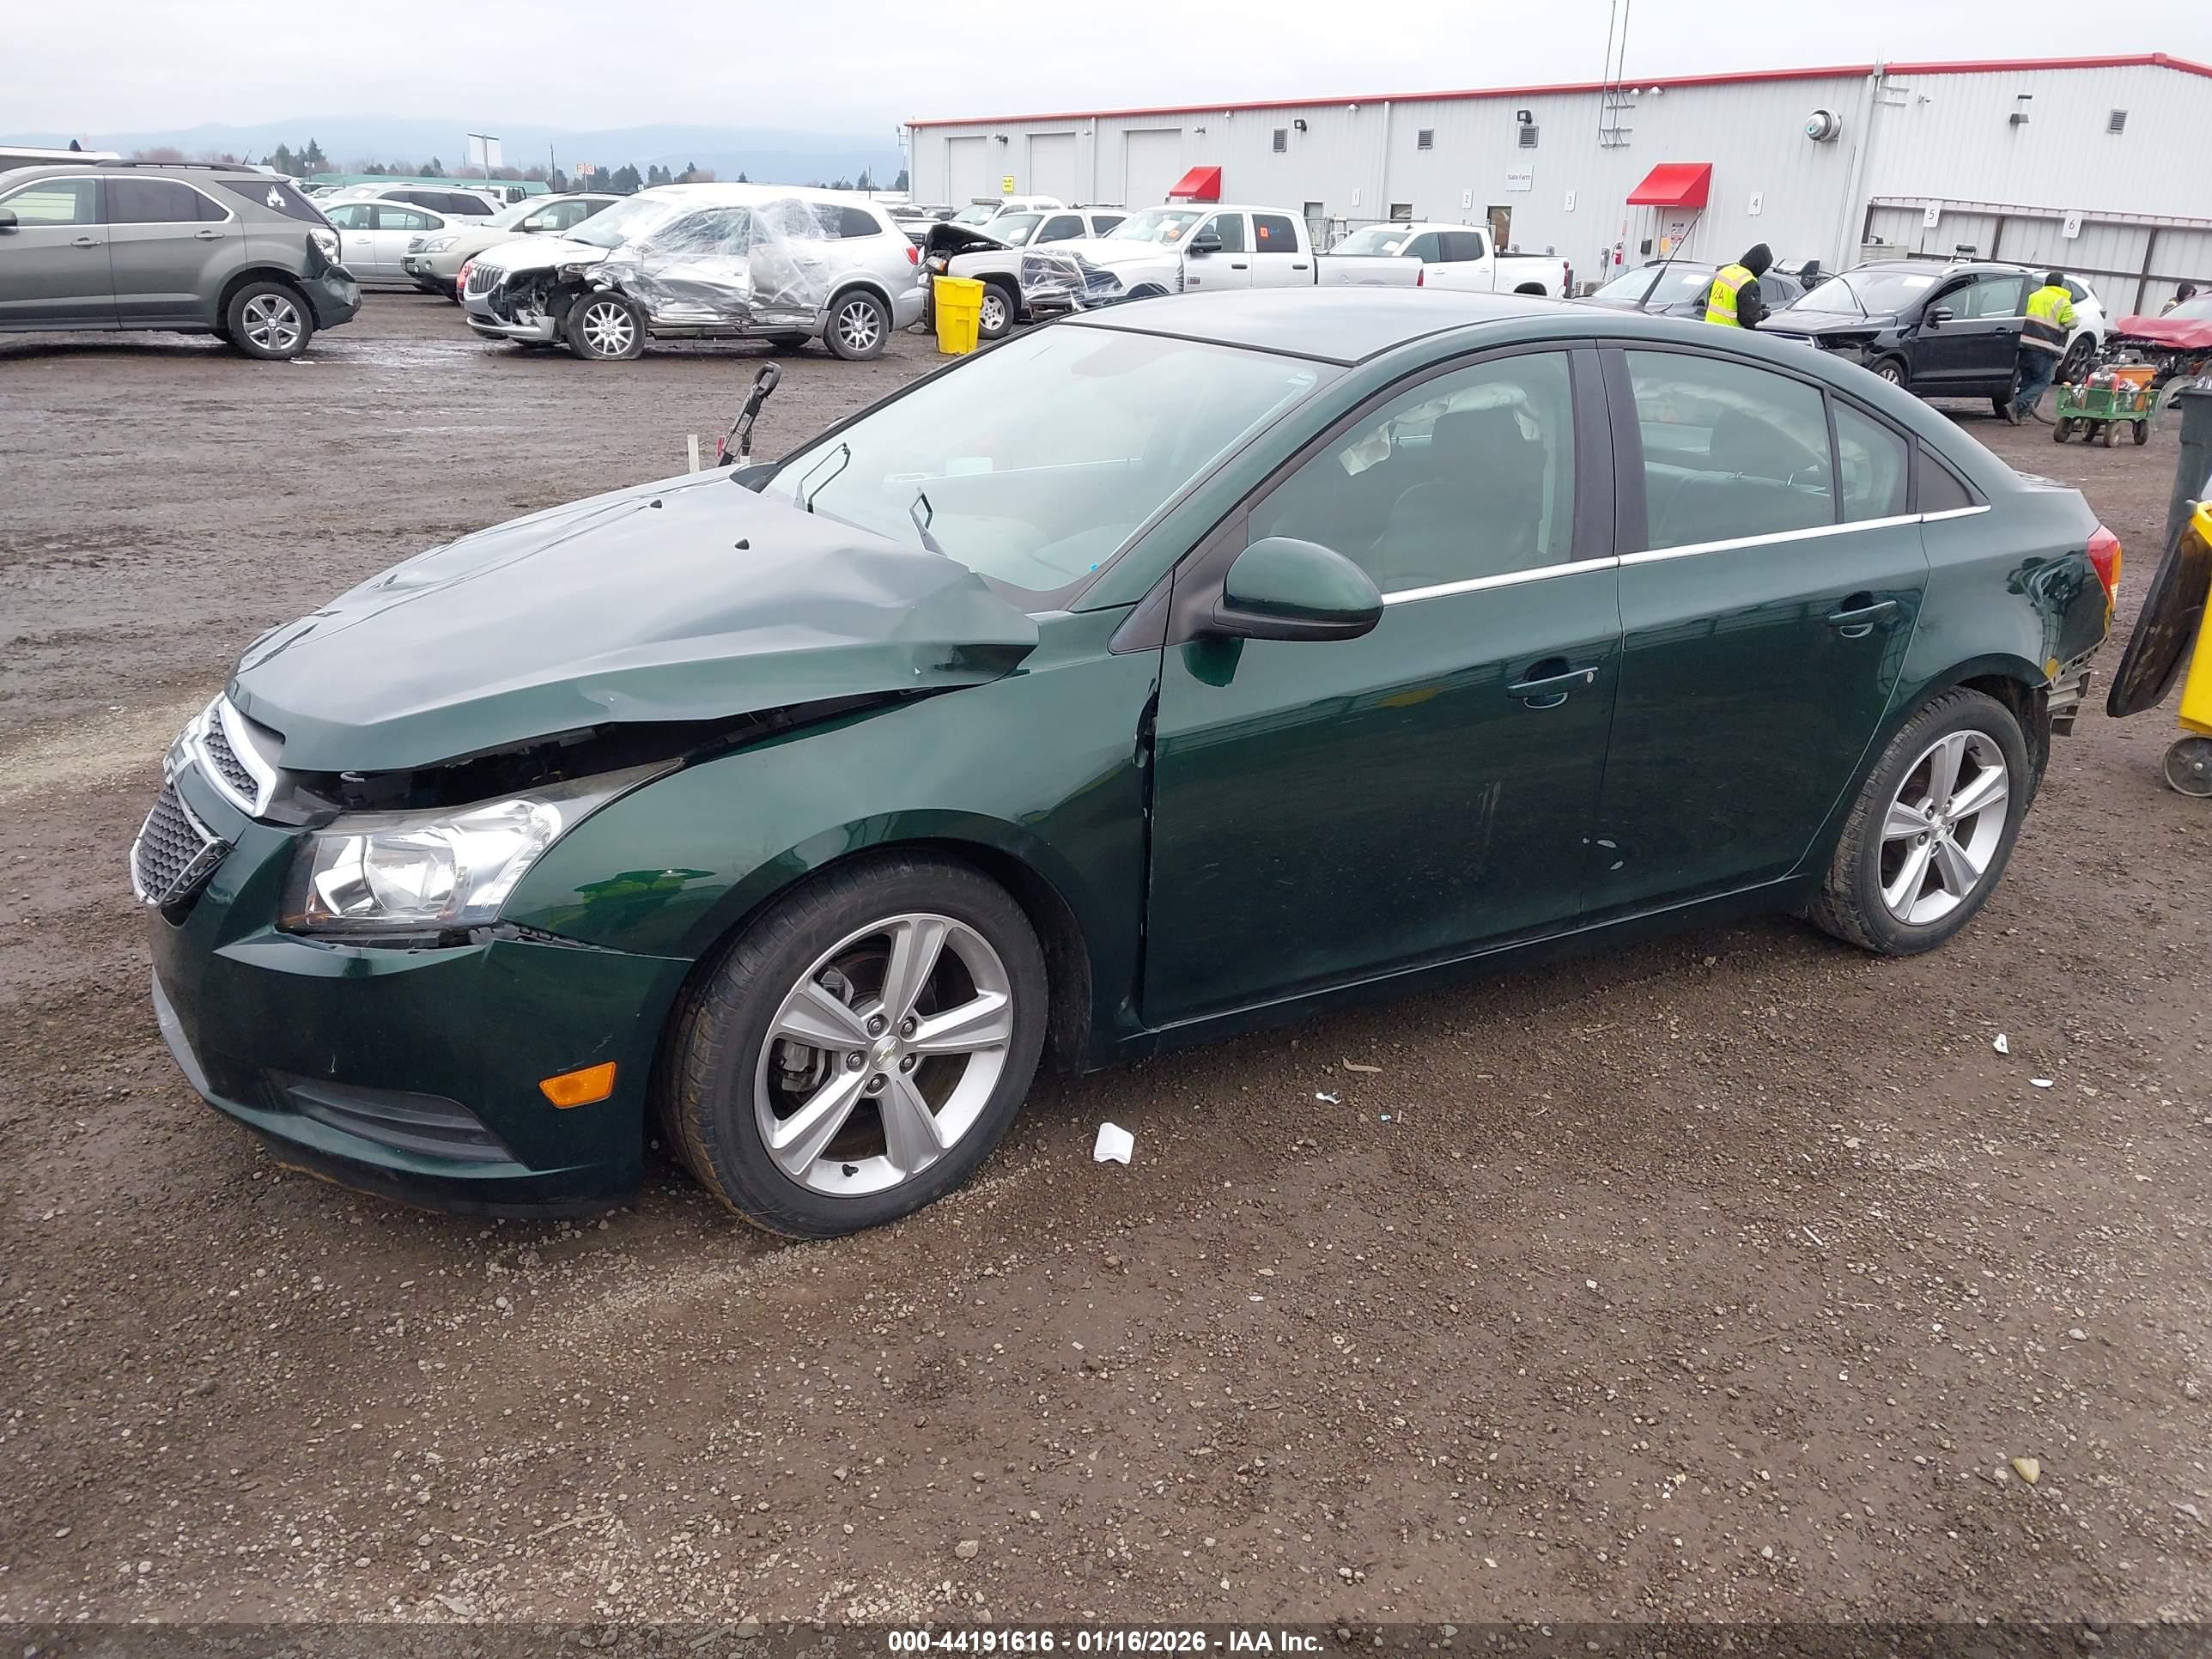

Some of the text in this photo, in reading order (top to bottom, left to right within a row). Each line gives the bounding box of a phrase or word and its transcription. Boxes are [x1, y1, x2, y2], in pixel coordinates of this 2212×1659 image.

[1464, 194, 1470, 204] 2
[1567, 196, 1572, 205] 3
[1753, 198, 1759, 209] 4
[1928, 209, 1936, 220] 5
[2069, 219, 2075, 230] 6
